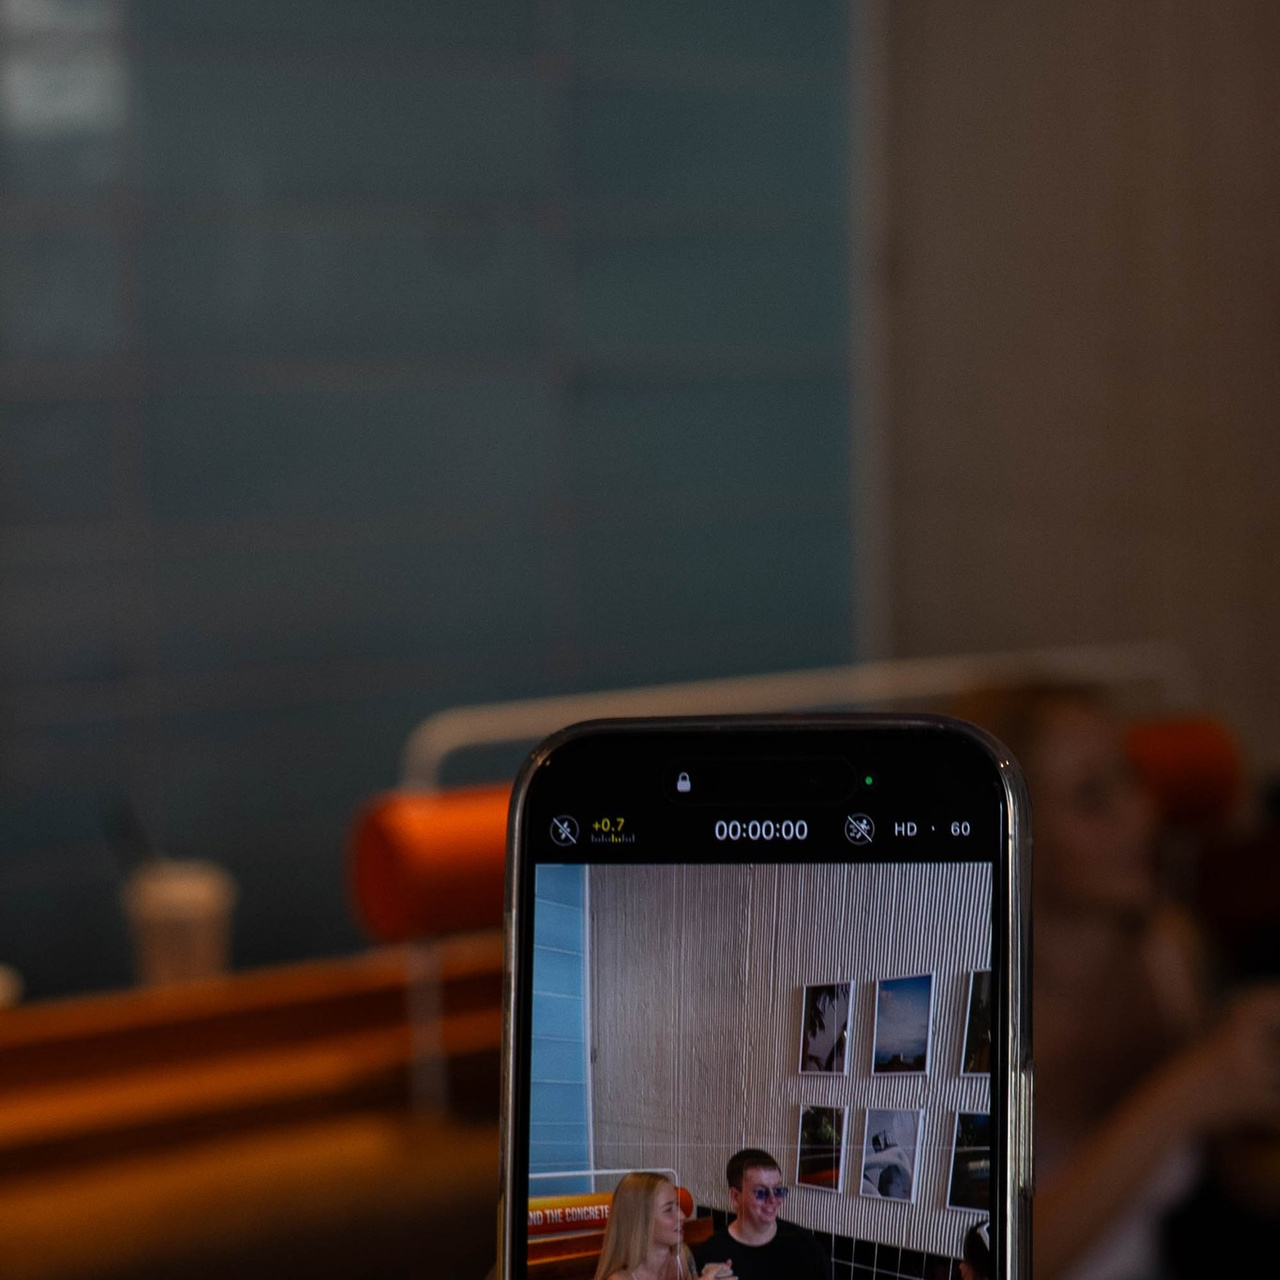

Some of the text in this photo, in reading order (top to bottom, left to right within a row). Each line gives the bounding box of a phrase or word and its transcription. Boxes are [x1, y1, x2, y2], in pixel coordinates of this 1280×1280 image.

[592, 816, 625, 833] +0.7
[714, 819, 809, 841] 00:00:00
[894, 820, 971, 837] HD 60
[527, 1204, 610, 1226] ND THE CONCRETE
